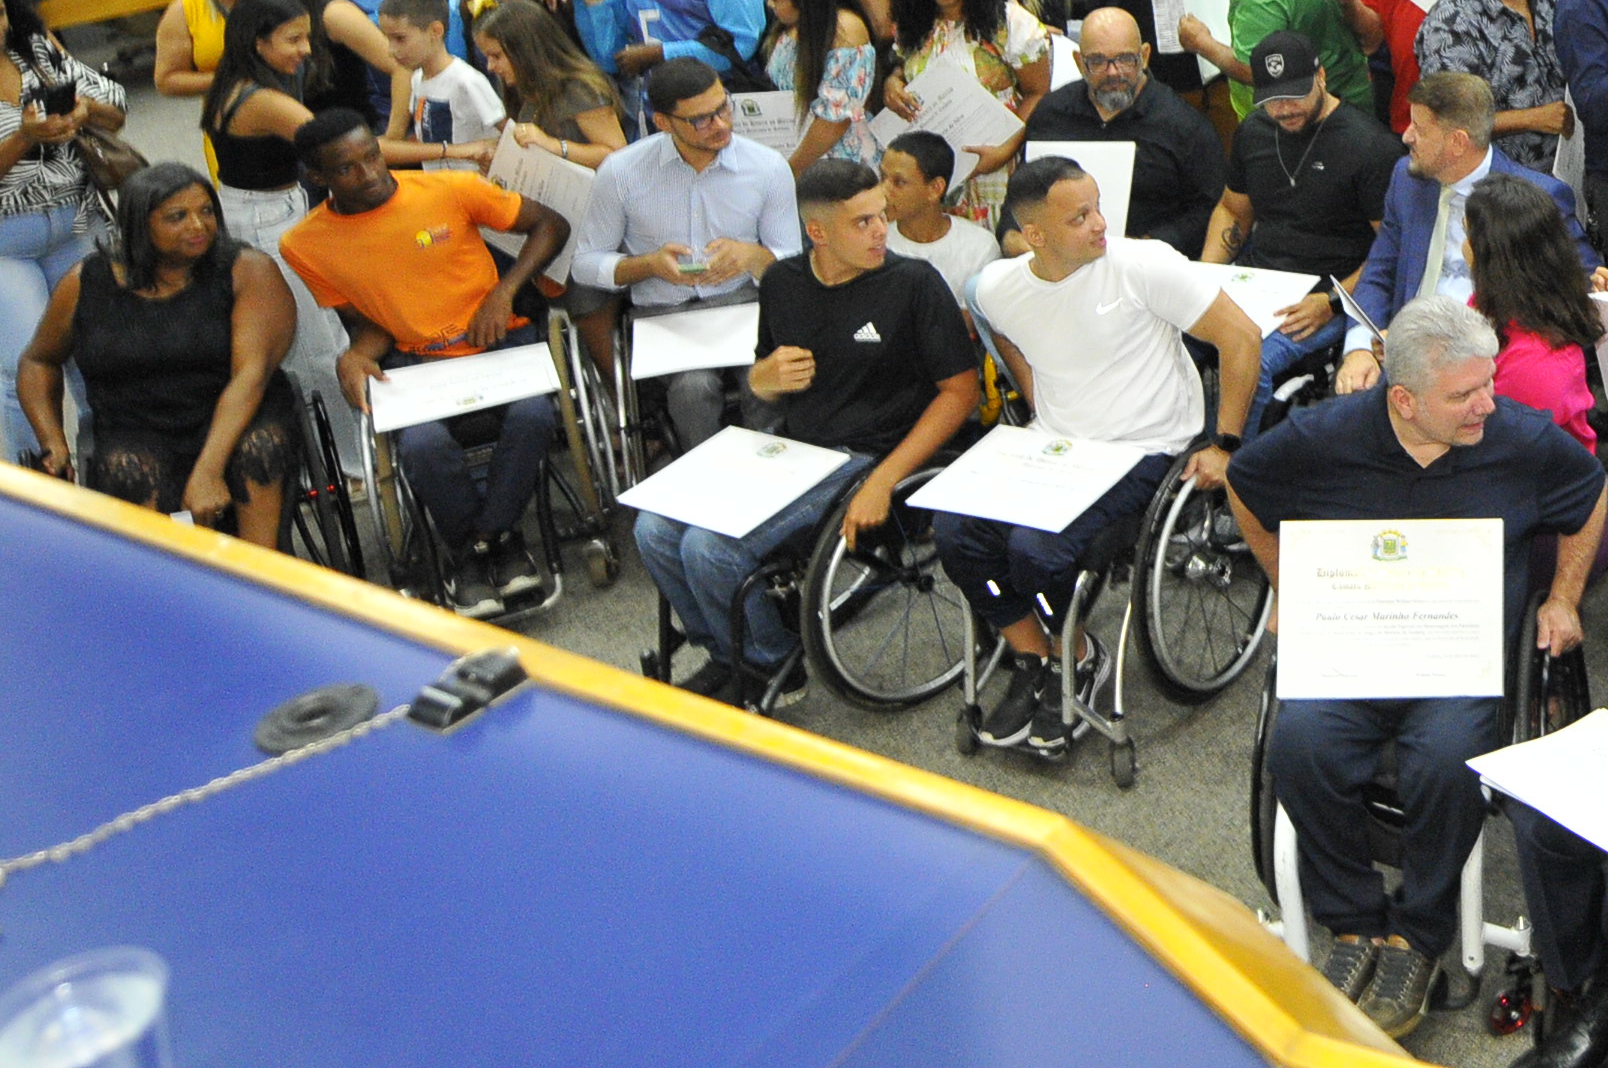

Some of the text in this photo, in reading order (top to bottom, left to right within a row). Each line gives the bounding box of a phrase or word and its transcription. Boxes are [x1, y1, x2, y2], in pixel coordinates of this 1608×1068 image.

[1316, 612, 1458, 621] Paulo Cesar Marinho Fernandes
